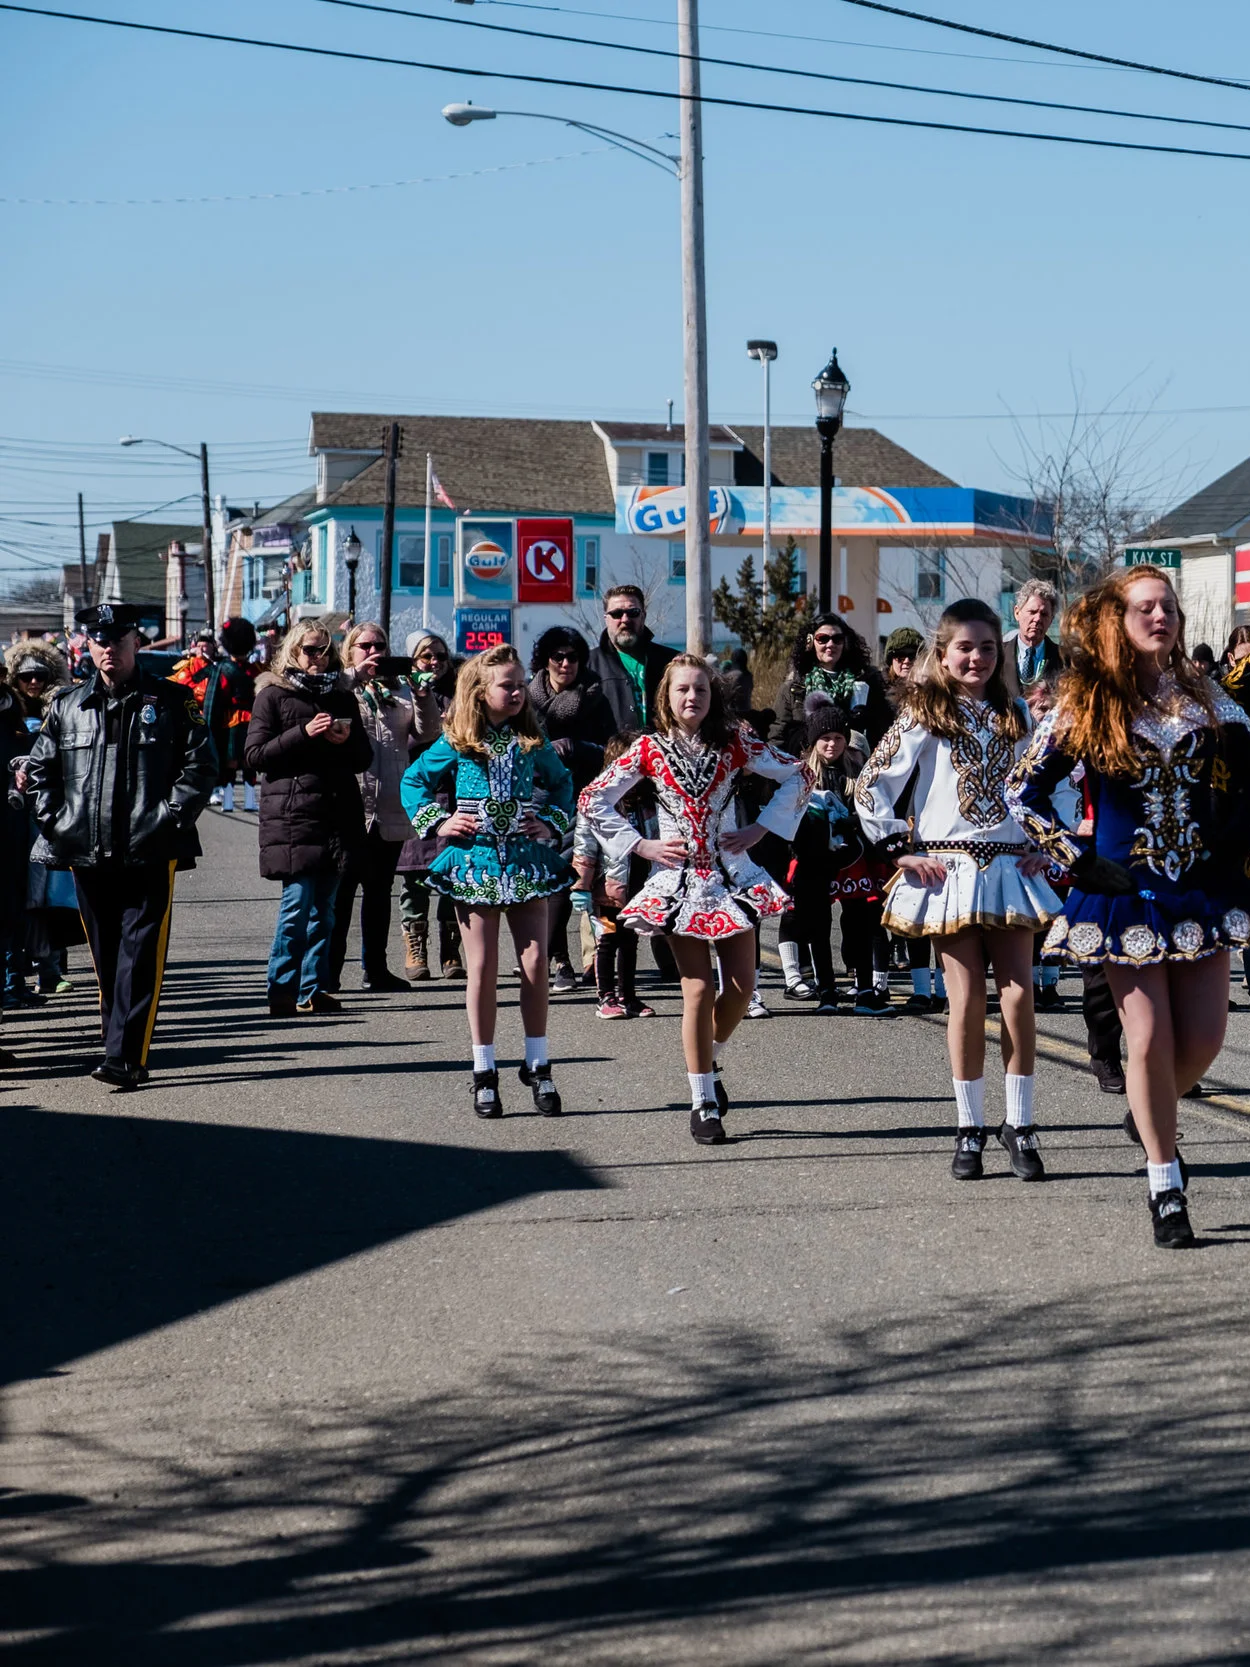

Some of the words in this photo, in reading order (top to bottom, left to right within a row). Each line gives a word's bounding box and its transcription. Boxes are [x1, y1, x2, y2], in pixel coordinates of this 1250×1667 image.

[635, 490, 718, 532] Guf
[469, 555, 506, 567] Gulf
[534, 546, 563, 578] K
[1132, 551, 1153, 565] KAY
[1160, 552, 1173, 566] ST
[461, 613, 507, 622] REGULAR
[472, 622, 498, 631] CASH
